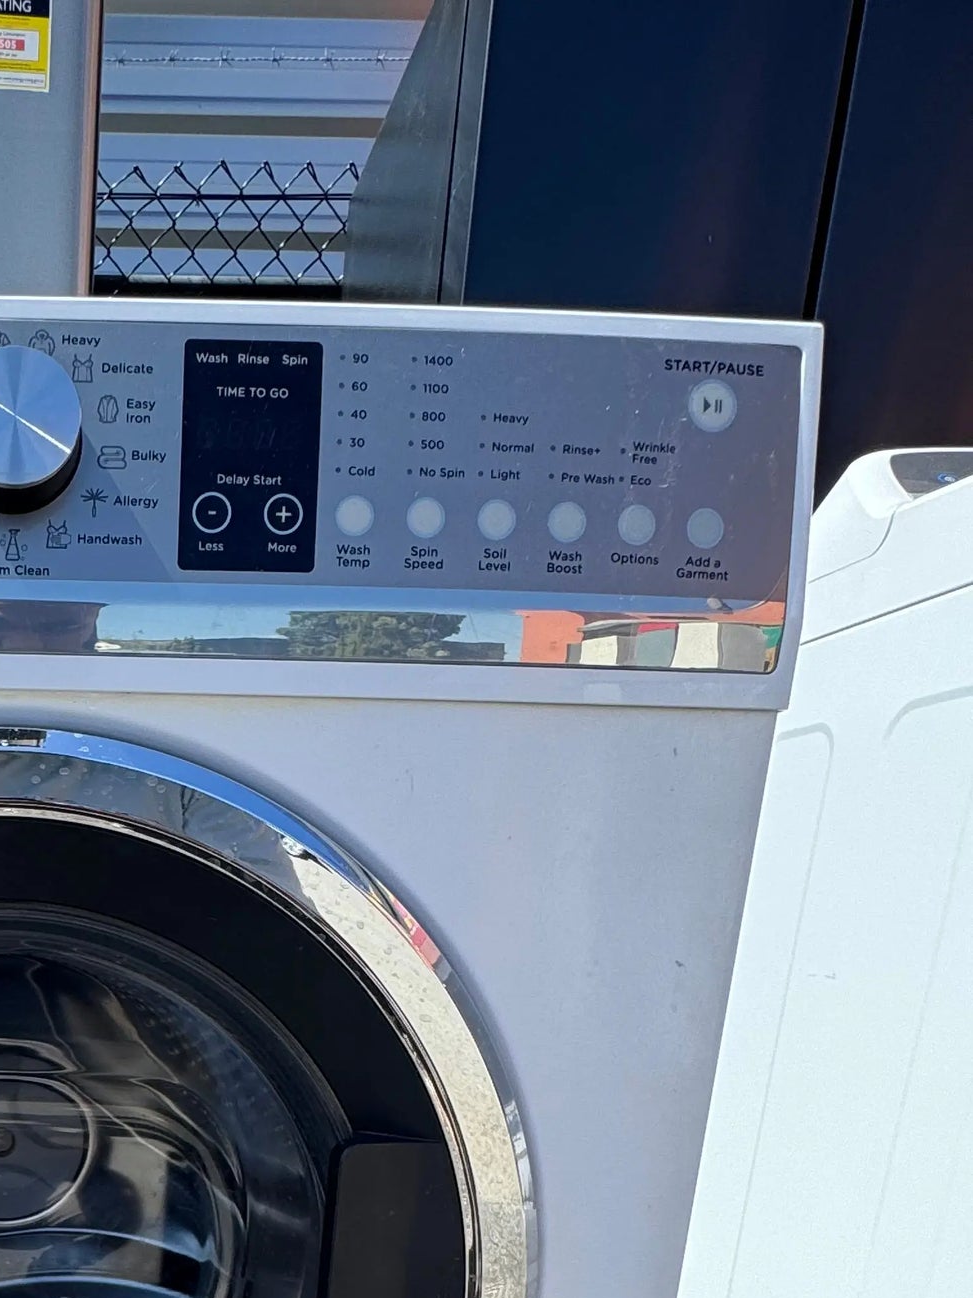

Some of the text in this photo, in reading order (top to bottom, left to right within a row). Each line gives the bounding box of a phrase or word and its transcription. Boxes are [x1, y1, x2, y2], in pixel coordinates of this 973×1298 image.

[0, 39, 17, 49] 505
[62, 335, 101, 348] Heavy
[196, 352, 308, 367] Wash Rinse Spin
[352, 353, 369, 364] 90
[423, 355, 454, 366] 1400
[101, 362, 154, 375] Delicate
[664, 358, 765, 377] START/PAUSE
[216, 386, 289, 398] TIME TO GO
[351, 381, 368, 392] 60
[422, 383, 450, 394] 1100
[126, 398, 156, 412] Easy
[126, 413, 151, 424] Iron
[350, 409, 368, 420] 40
[421, 411, 446, 422] 800
[493, 412, 529, 426] Heavy
[349, 437, 366, 448] 30
[420, 439, 445, 450] 500
[491, 442, 535, 453] Normal
[632, 442, 676, 454] Wrinkle
[562, 444, 601, 456] Rinse+
[131, 450, 167, 463] Bulky
[632, 454, 658, 465] Free
[348, 466, 376, 477] Cold
[419, 468, 465, 480] No Spin
[490, 469, 520, 481] Light
[217, 474, 282, 487] Delay Start
[561, 472, 615, 485] Pre Wash
[630, 475, 652, 486] Eco
[113, 495, 159, 509] Allergy
[77, 534, 143, 546] Handwash
[198, 541, 224, 551] Less
[267, 542, 297, 553] More
[336, 544, 371, 555] Wash
[410, 546, 439, 558] Spin
[483, 548, 507, 560] Soil
[548, 550, 582, 562] Wash
[610, 552, 659, 566] Options
[336, 557, 370, 569] Temp
[404, 558, 444, 570] Speed
[478, 560, 511, 572] Level
[685, 556, 721, 569] Add a
[14, 564, 50, 577] Clean
[546, 563, 583, 575] Boost
[676, 568, 729, 582] Garment
